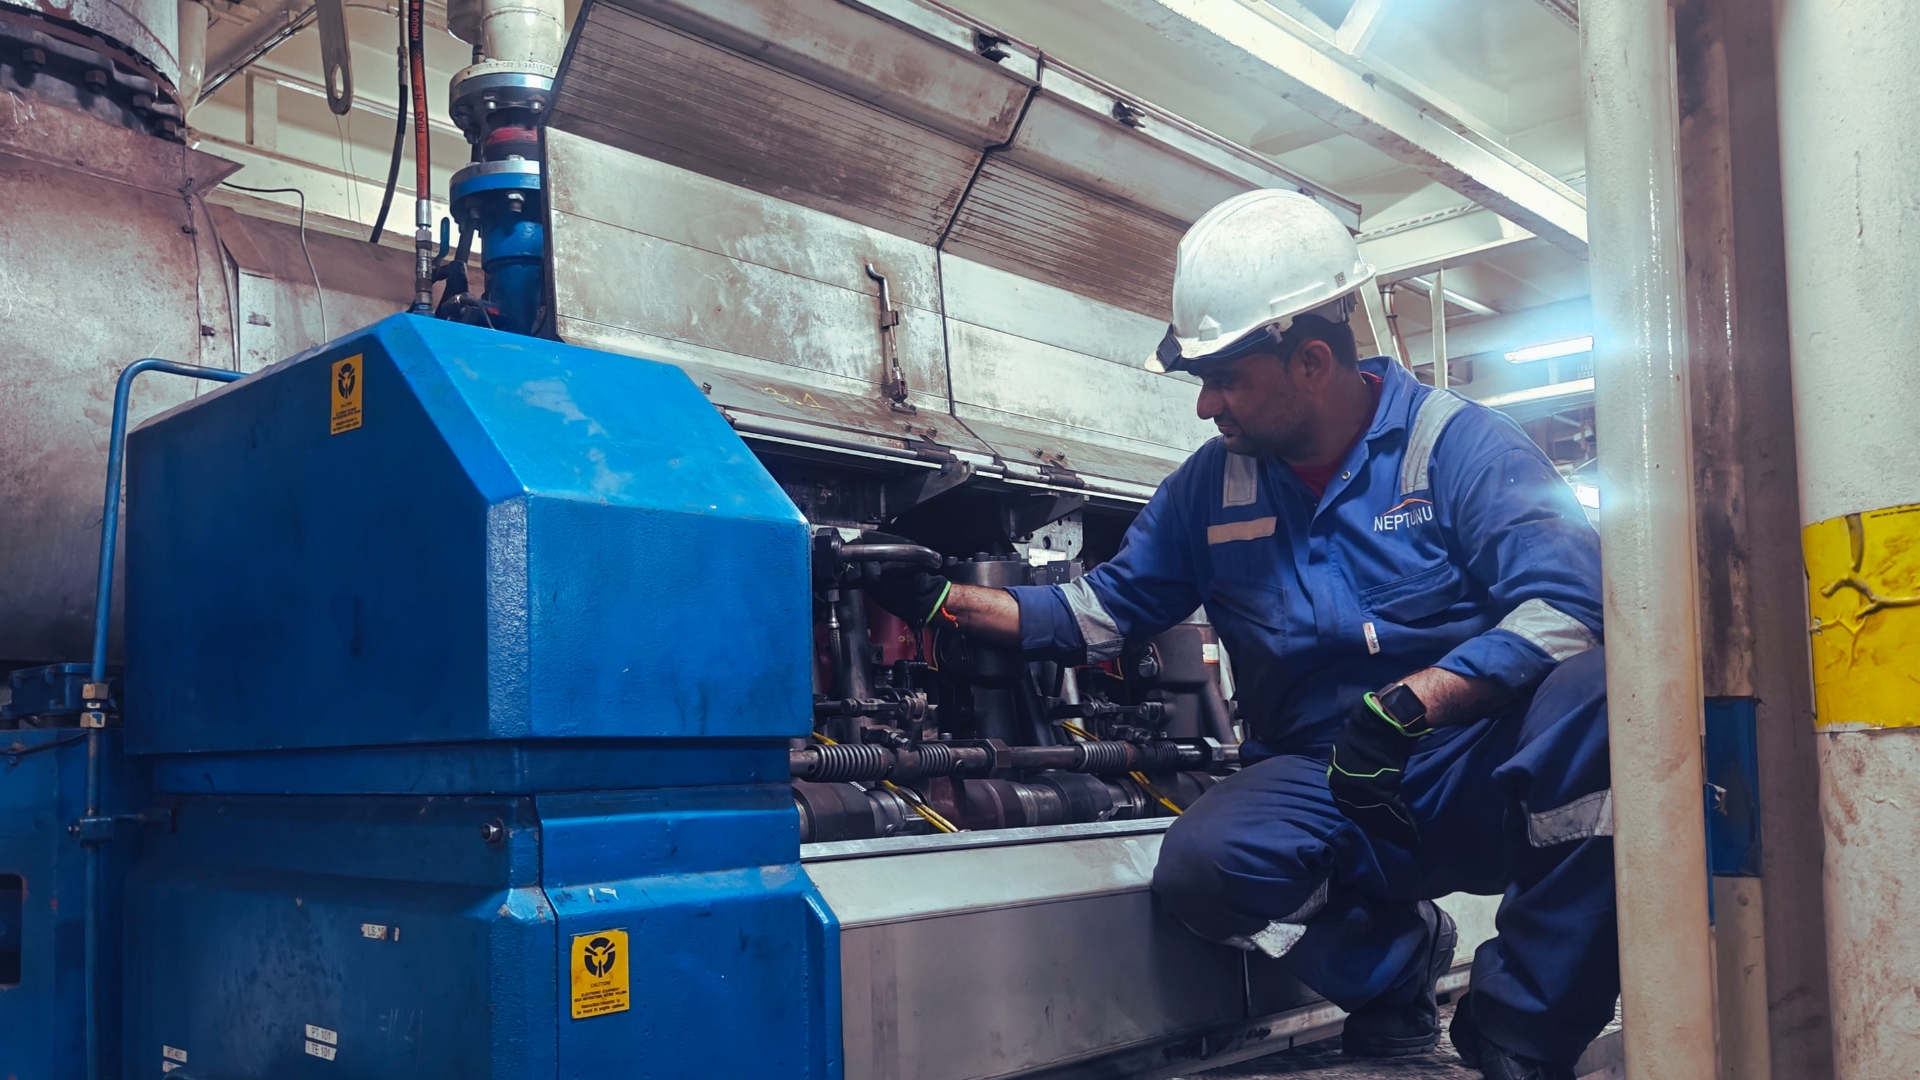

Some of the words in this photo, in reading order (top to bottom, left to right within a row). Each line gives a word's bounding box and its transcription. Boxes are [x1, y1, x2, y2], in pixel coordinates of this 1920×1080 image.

[417, 111, 425, 134] FRAS
[1373, 505, 1433, 532] NEPTUNU
[367, 925, 376, 937] LS
[311, 1027, 320, 1038] PT
[311, 1043, 319, 1055] TE
[321, 1046, 331, 1058] 101
